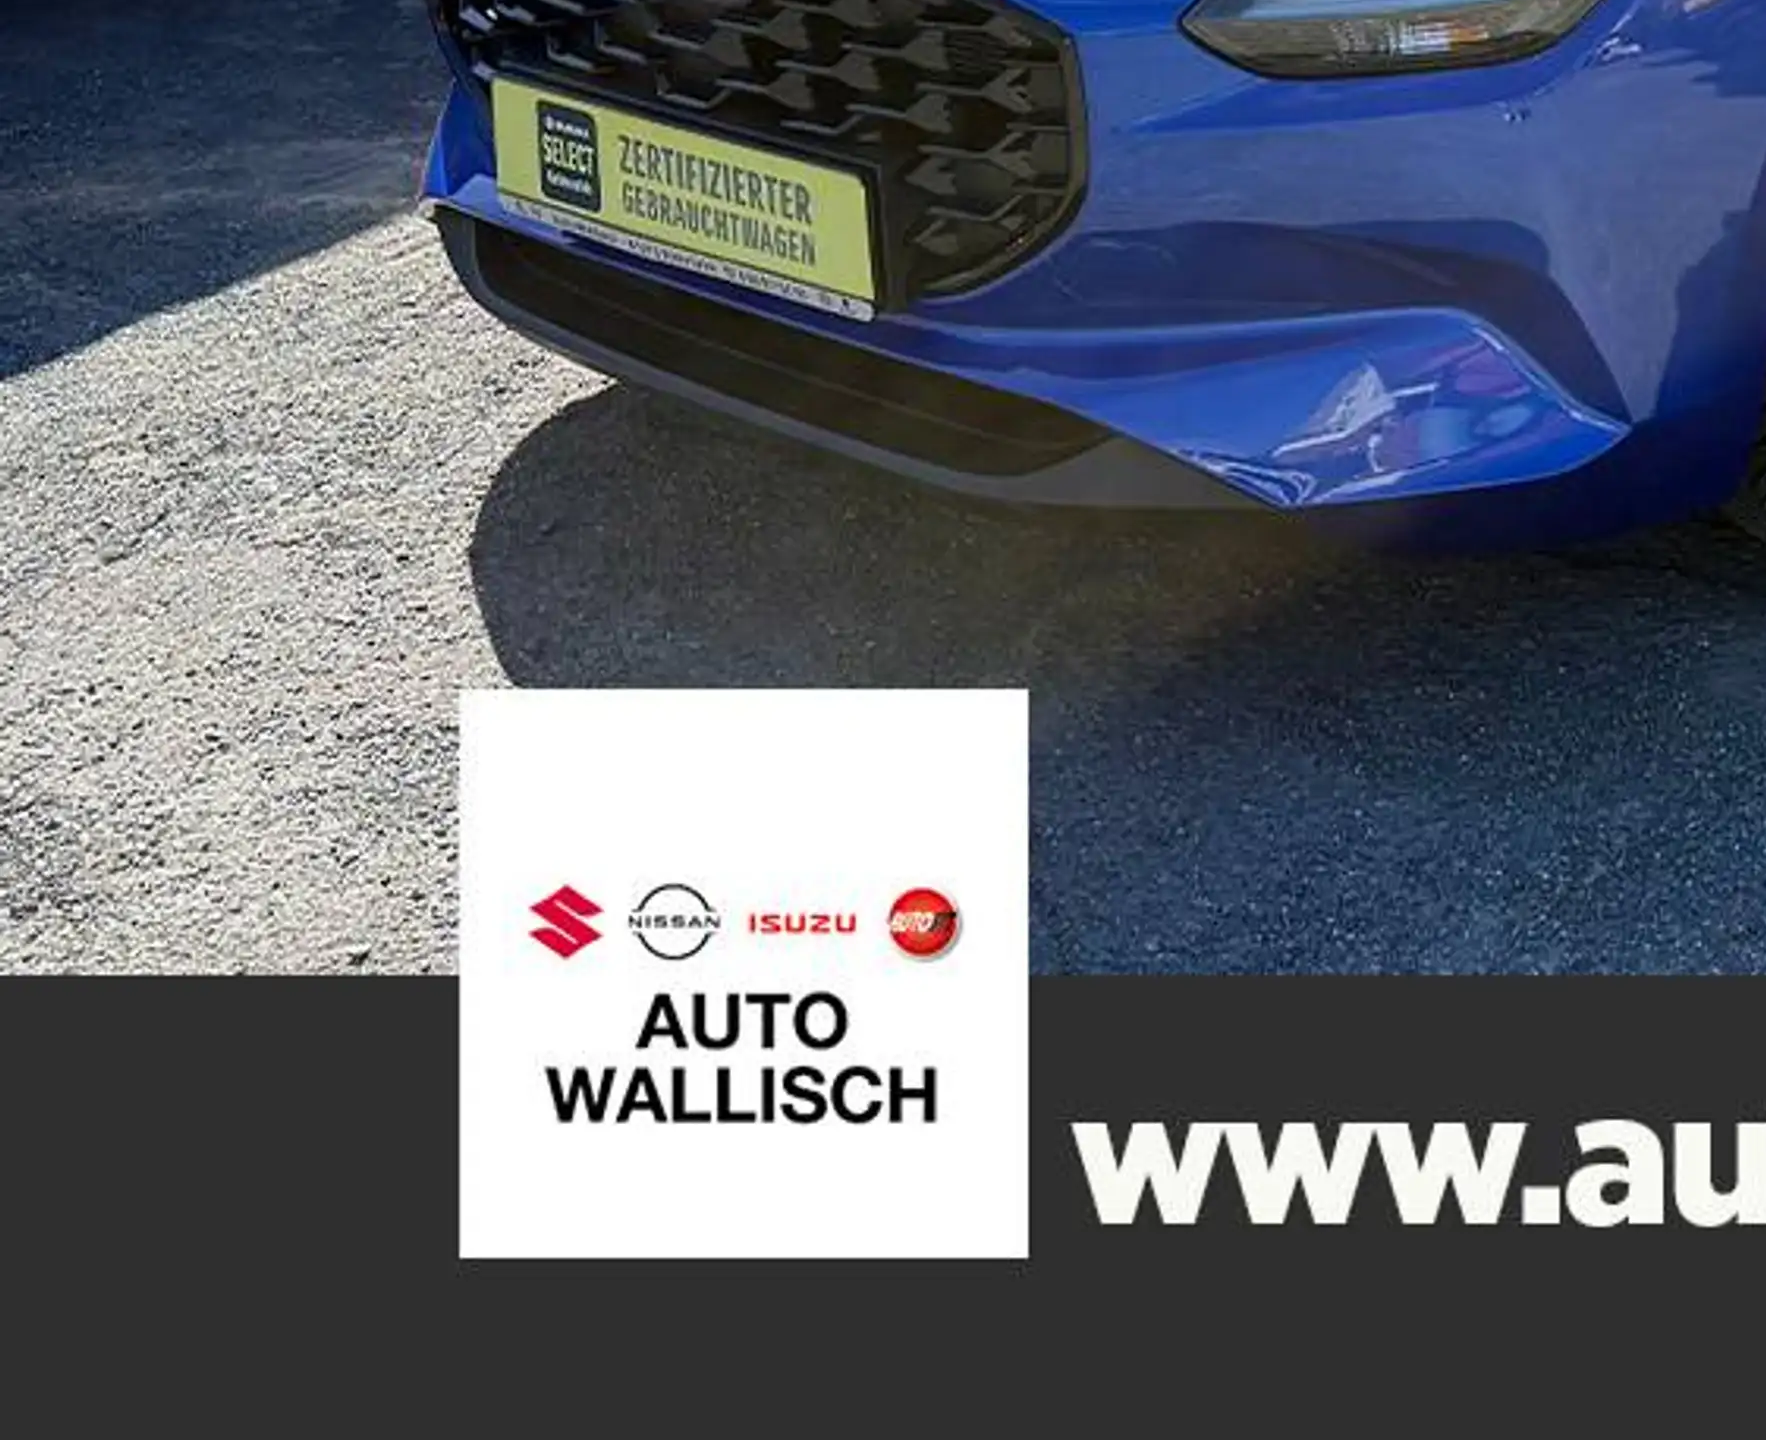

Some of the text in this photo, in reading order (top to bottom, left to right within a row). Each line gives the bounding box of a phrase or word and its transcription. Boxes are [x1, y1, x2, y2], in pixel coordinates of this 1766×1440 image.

[543, 132, 595, 178] SELECT
[617, 134, 813, 225] ZERTIFIZIERTER
[621, 181, 816, 266] GEBRAUCHTWAGEN
